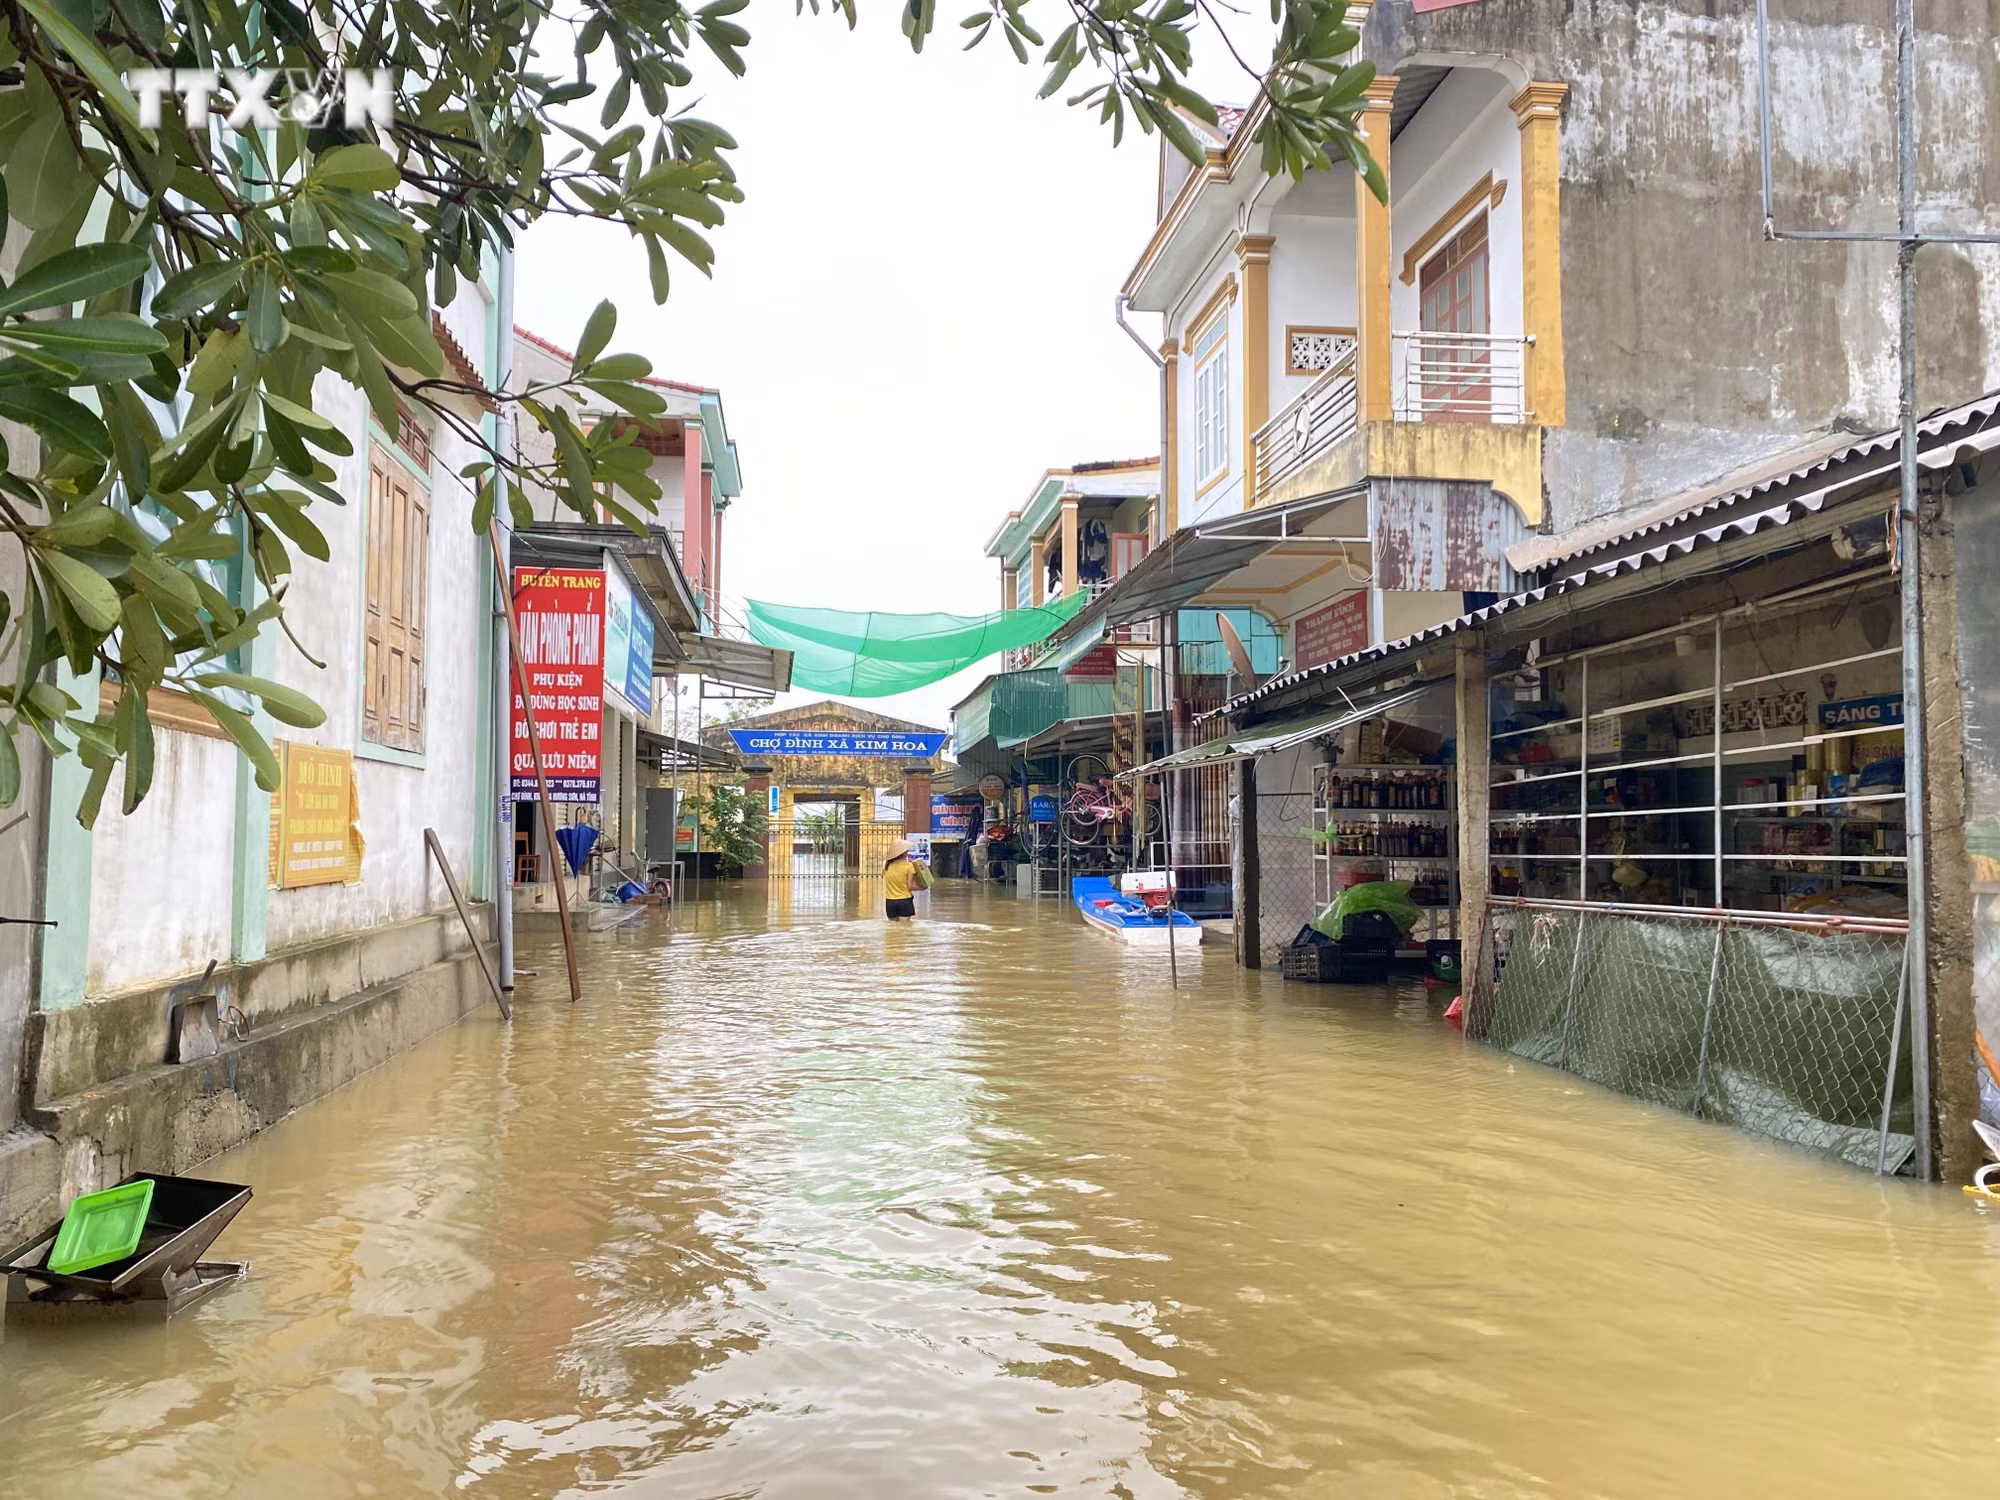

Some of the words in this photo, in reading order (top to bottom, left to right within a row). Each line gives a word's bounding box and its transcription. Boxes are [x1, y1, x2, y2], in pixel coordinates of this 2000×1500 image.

[562, 576, 601, 589] TRANG
[520, 600, 539, 664] VĂN
[540, 599, 571, 665] PHÒNG
[572, 591, 600, 666] PHẨM
[533, 673, 554, 689] PHỤ
[557, 670, 583, 689] KIỆN
[531, 691, 556, 710] DÙNG
[558, 696, 576, 714] HỌC
[577, 696, 599, 711] SINH
[1824, 705, 1881, 723] SÁNG
[559, 717, 579, 740] TRẺ
[581, 723, 598, 740] EM
[750, 738, 781, 750] CHỢ
[785, 736, 824, 748] ĐÌNH
[827, 738, 849, 749] XÃ
[854, 740, 888, 750] KIM
[891, 741, 928, 751] HOA
[542, 752, 566, 769] LƯU
[568, 750, 597, 773] NIỆM
